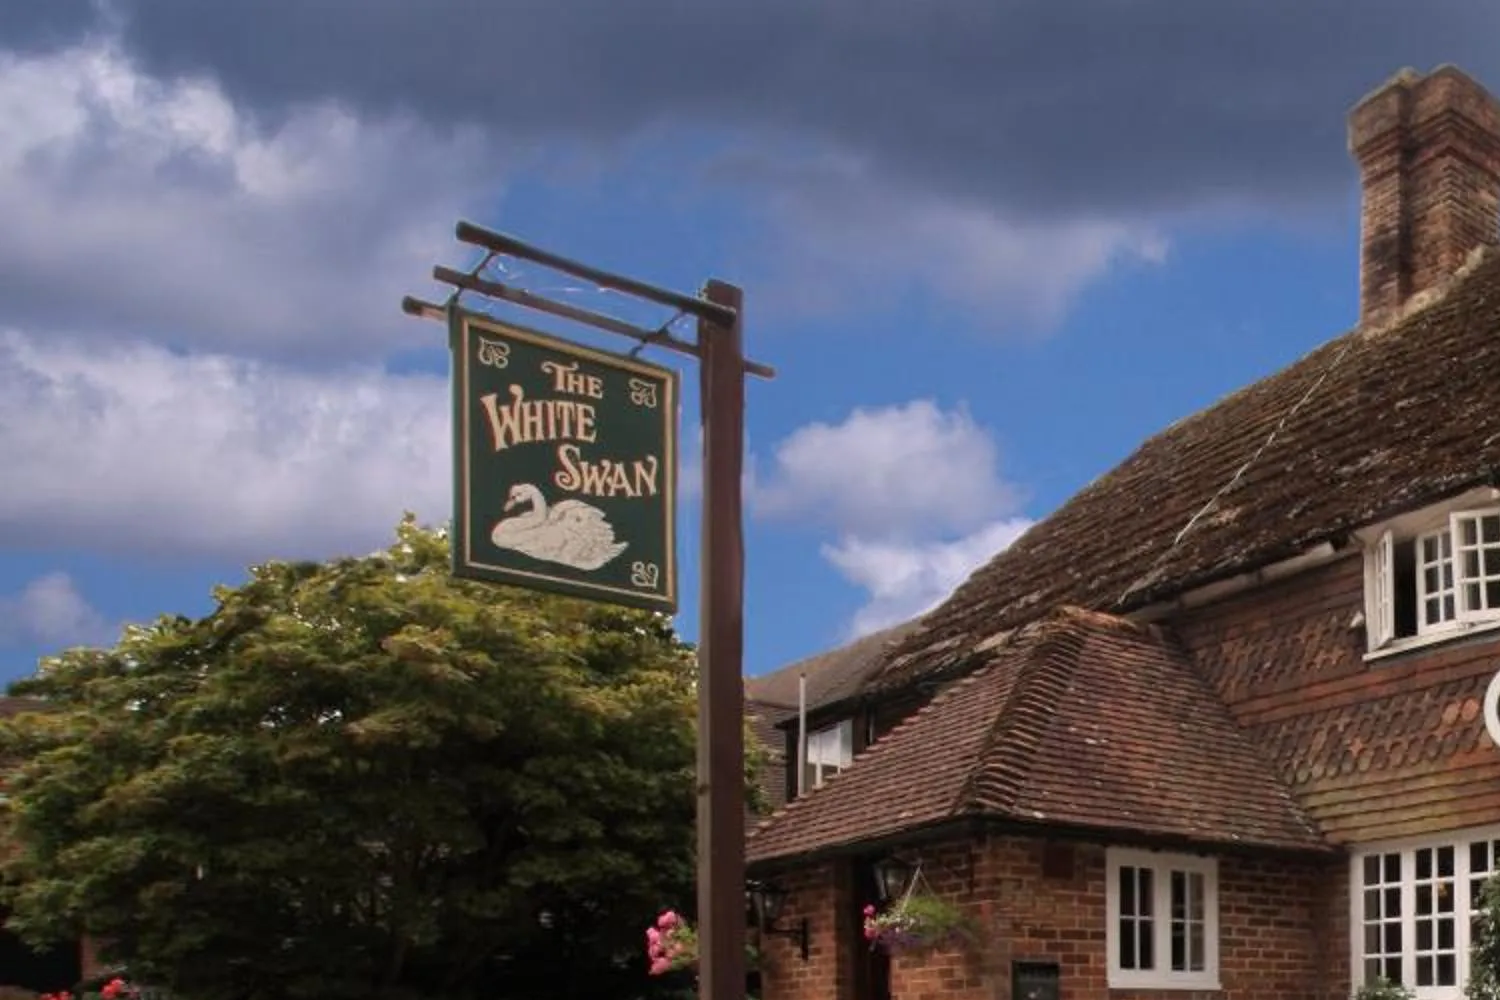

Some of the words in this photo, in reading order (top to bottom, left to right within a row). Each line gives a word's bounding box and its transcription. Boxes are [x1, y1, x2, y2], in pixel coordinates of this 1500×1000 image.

[541, 361, 604, 399] THE
[480, 384, 597, 451] WHITE
[555, 444, 658, 497] SWAN
